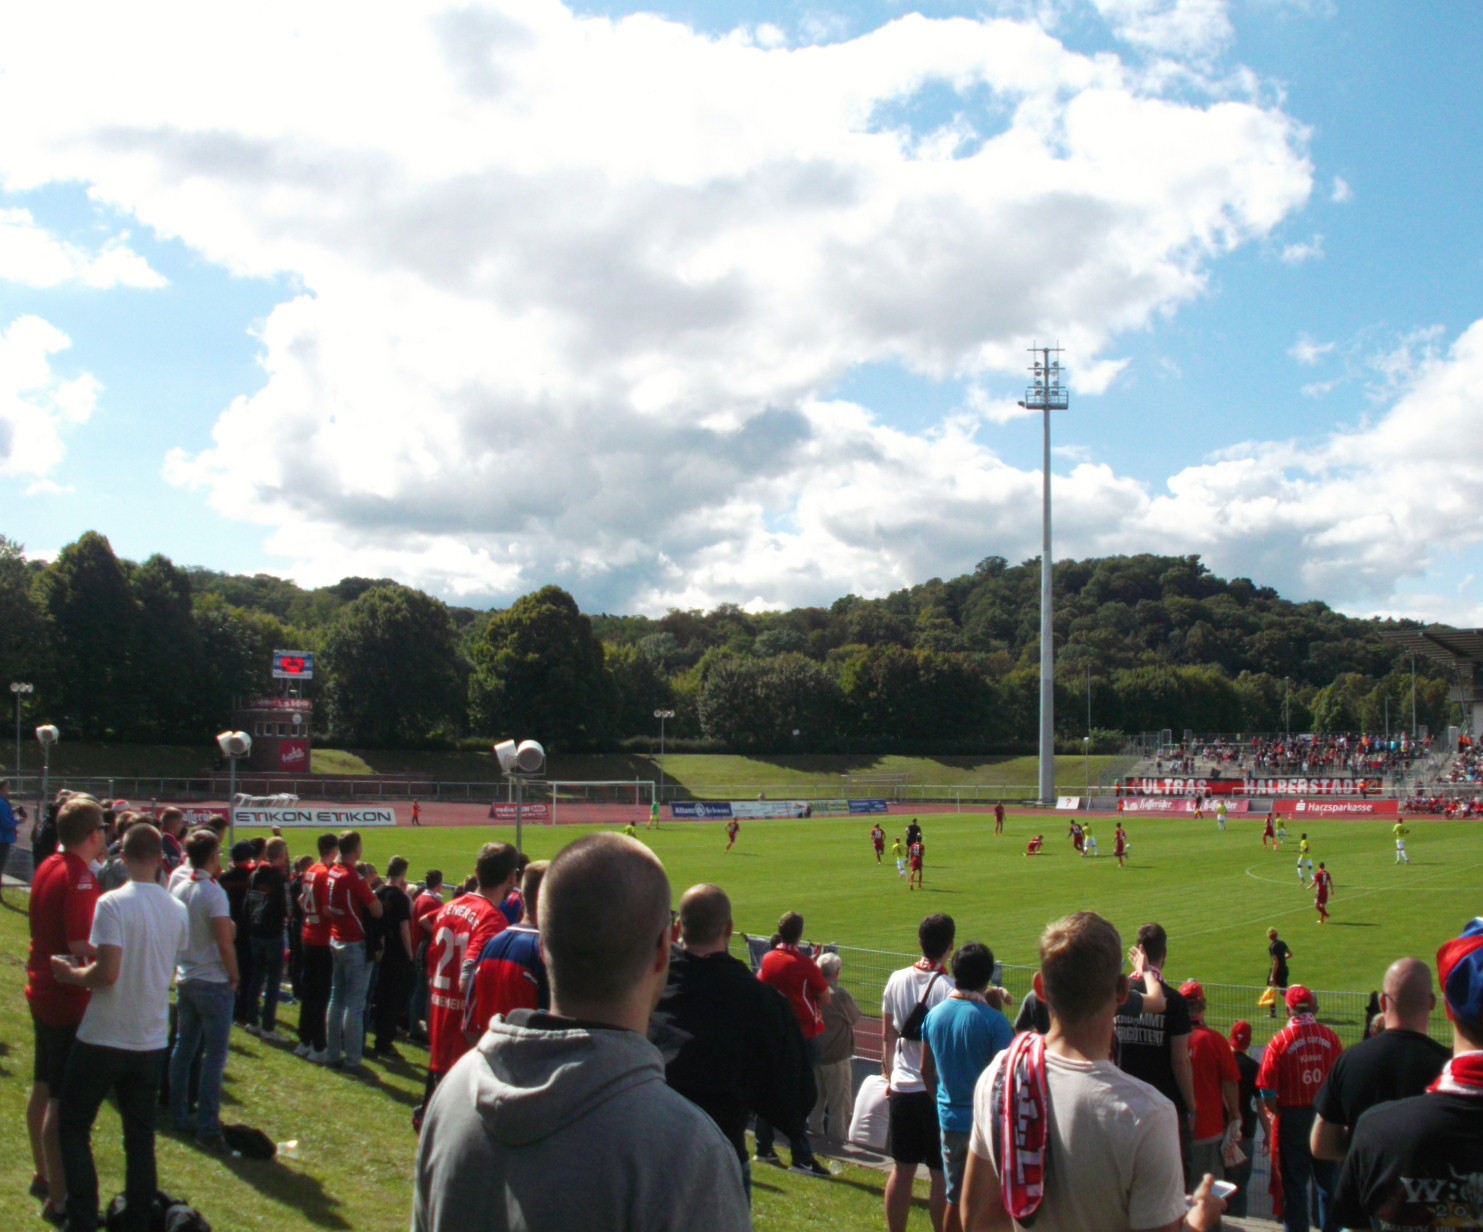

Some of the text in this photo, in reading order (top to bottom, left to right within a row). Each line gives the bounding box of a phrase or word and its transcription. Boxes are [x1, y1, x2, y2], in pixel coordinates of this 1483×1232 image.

[1142, 778, 1364, 796] ULTRAS HALBERSTADT
[1307, 801, 1373, 812] Harzsparkasse
[235, 809, 392, 822] ETIKON ETIKON
[433, 926, 471, 990] 21
[1302, 1068, 1322, 1085] 60
